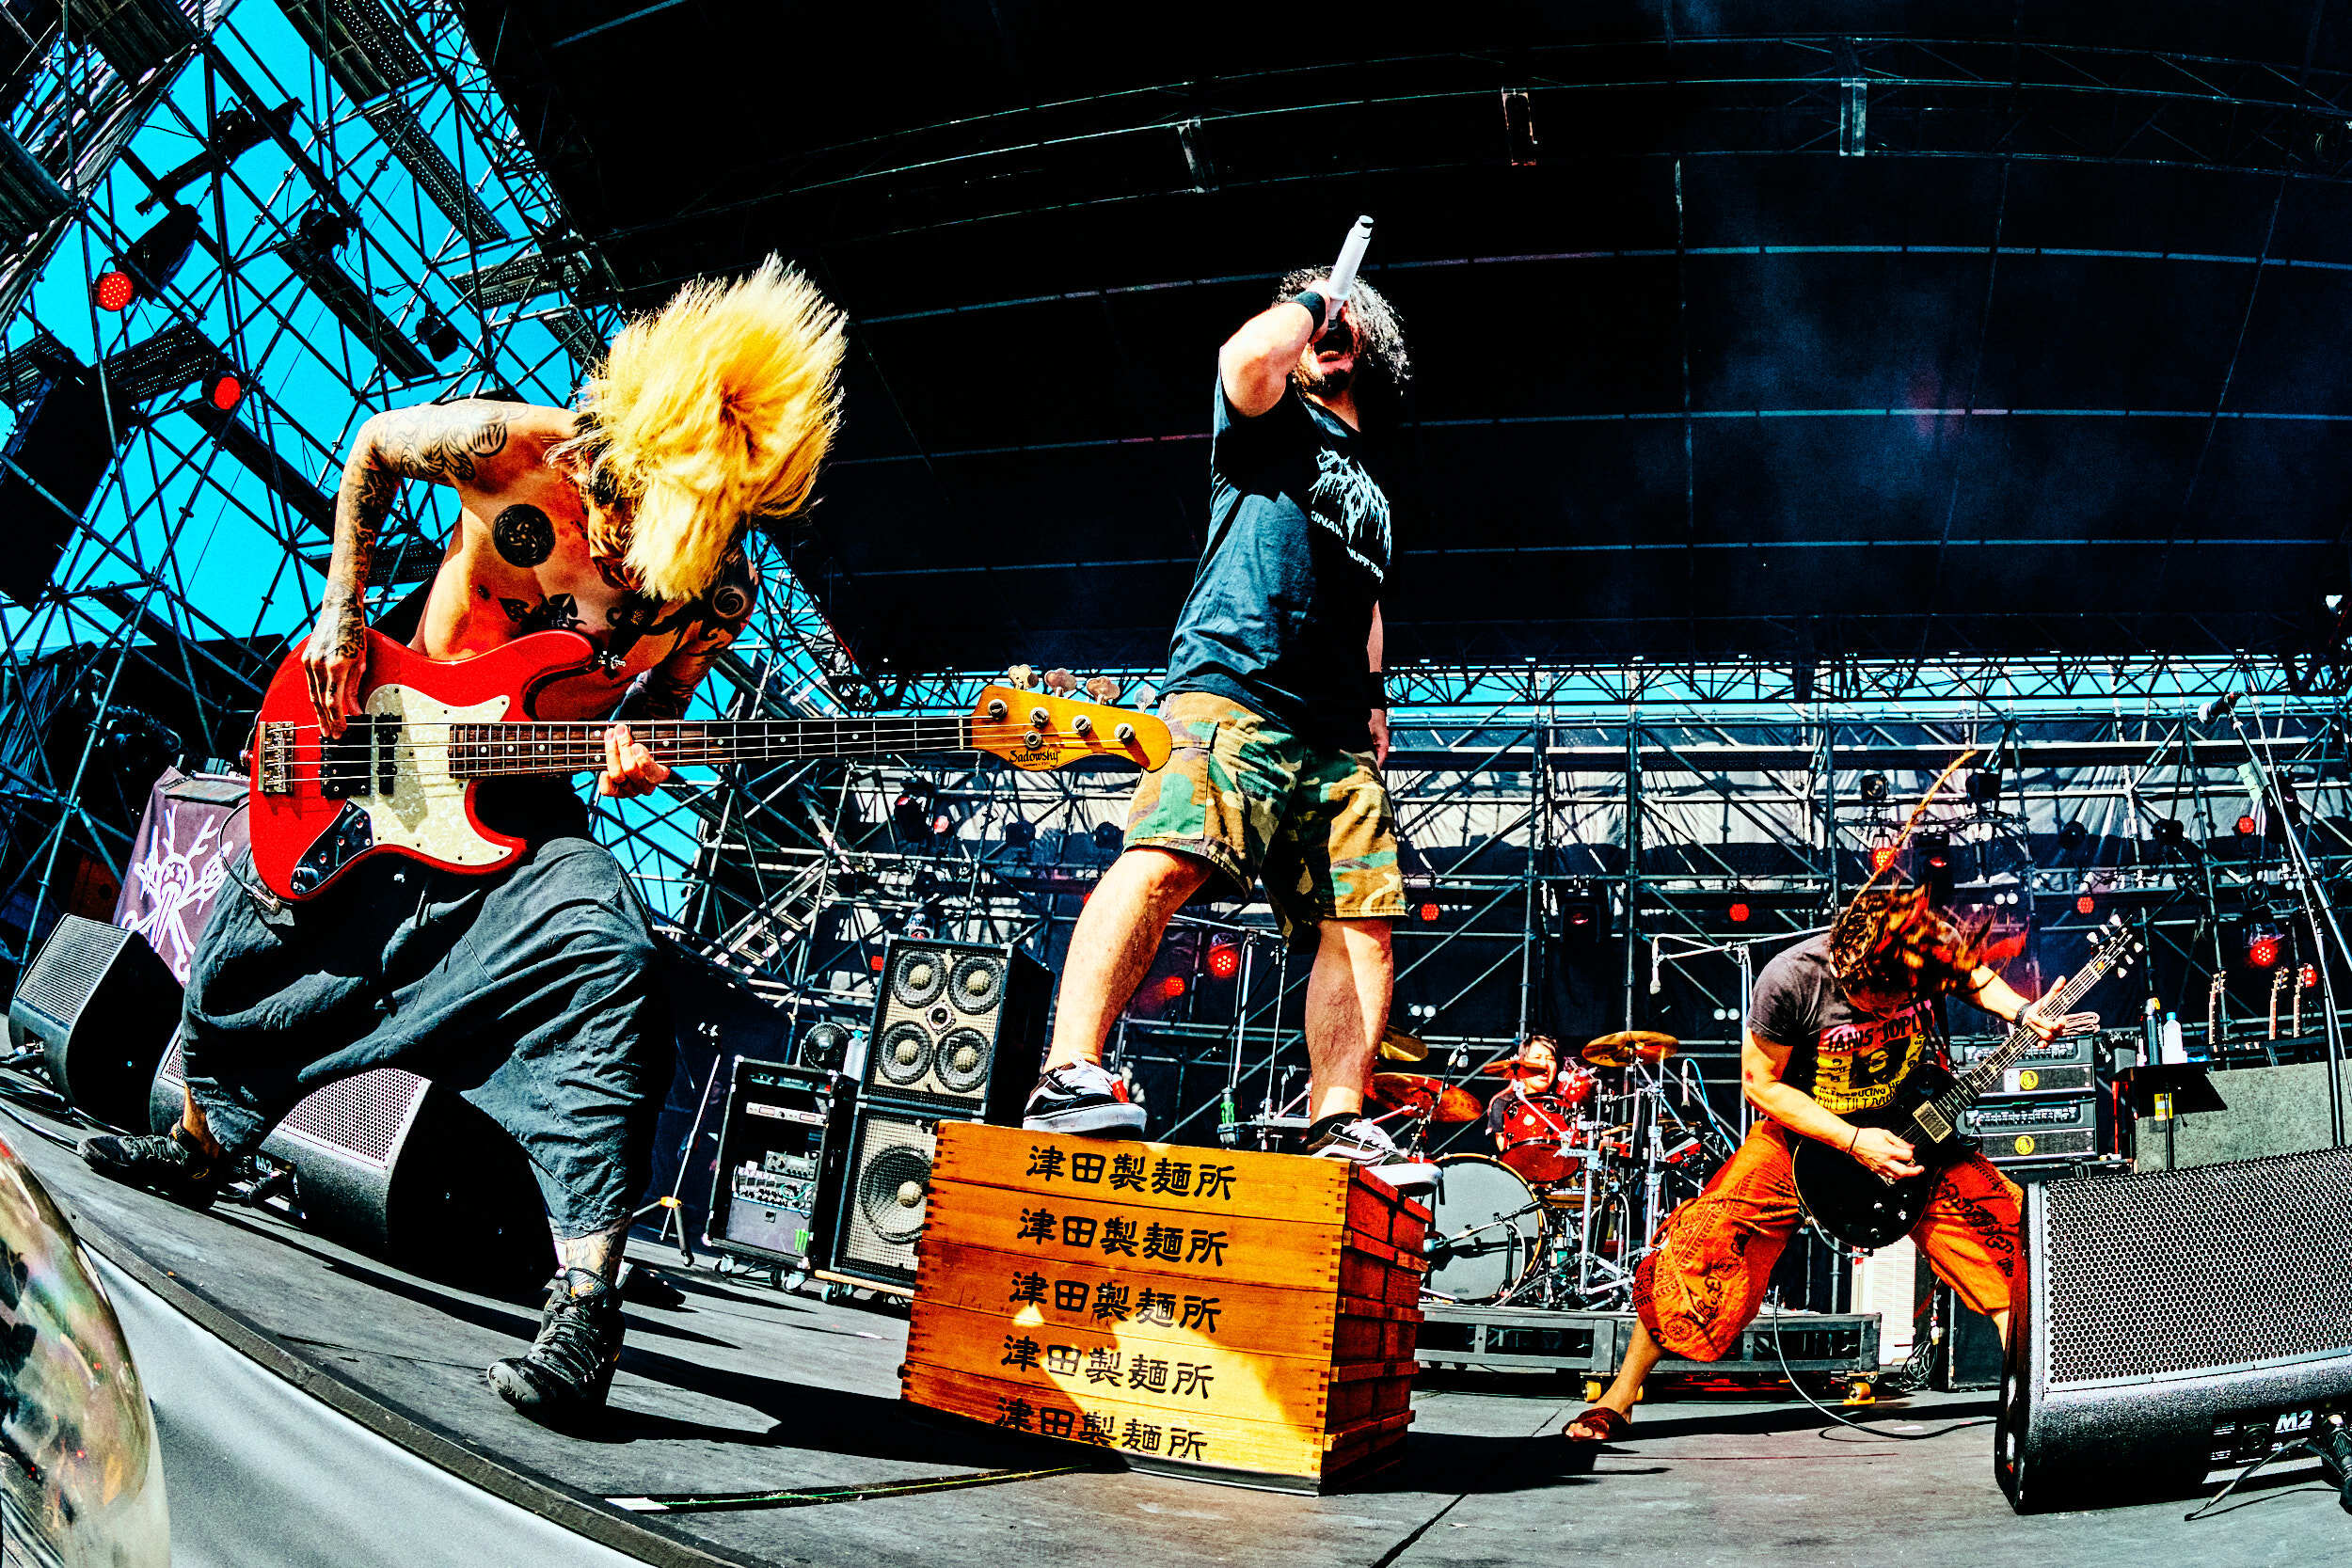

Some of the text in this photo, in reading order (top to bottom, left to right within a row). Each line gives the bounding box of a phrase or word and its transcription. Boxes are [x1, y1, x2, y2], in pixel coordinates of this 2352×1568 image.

[1009, 746, 1061, 768] Sadowsky
[1828, 1012, 1933, 1052] JANIS JOPL
[1820, 1085, 1886, 1099] INTUCING
[1026, 1145, 1236, 1200] 津田製麺所
[1017, 1208, 1229, 1266] 津田製麺所
[1009, 1271, 1222, 1334] 津田製麺所
[1000, 1334, 1215, 1399] 津田製麺所
[994, 1397, 1208, 1461] 津田製麺所
[2275, 1410, 2313, 1432] M2
